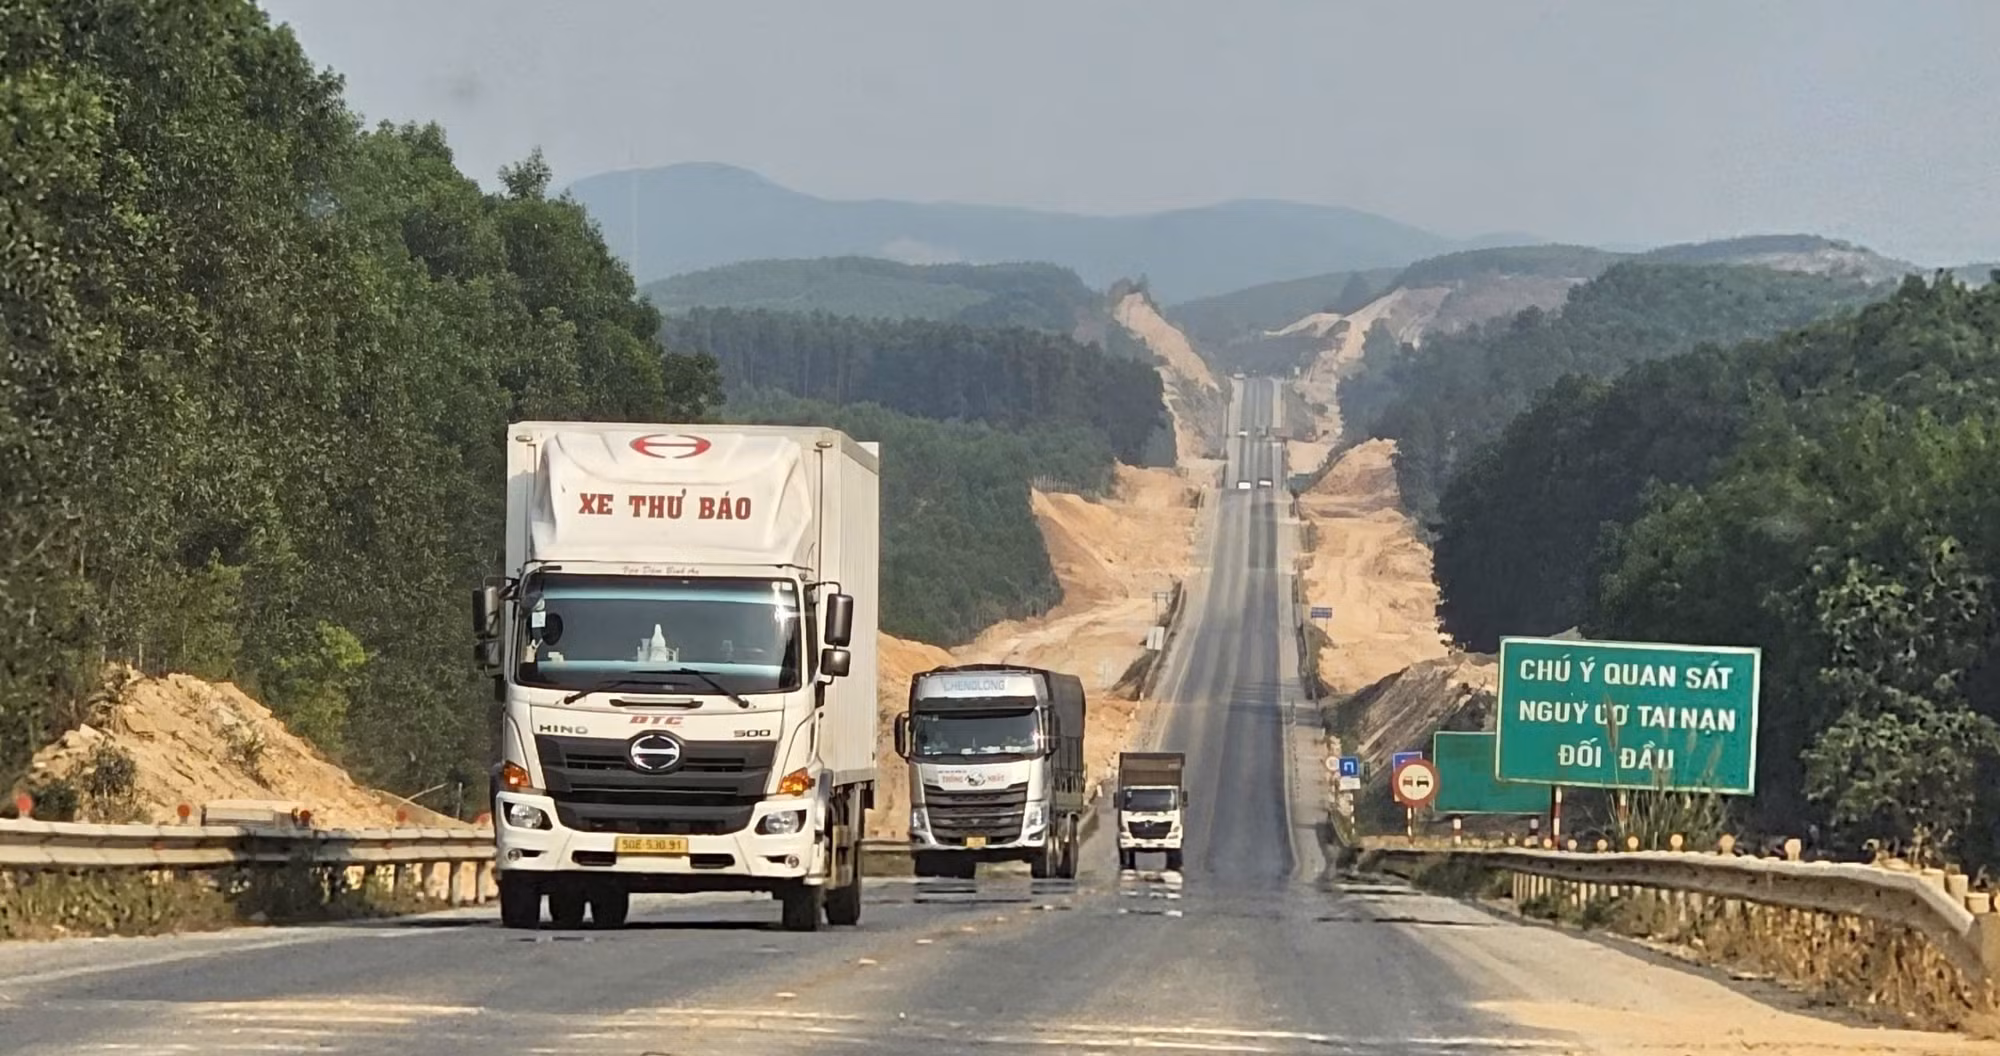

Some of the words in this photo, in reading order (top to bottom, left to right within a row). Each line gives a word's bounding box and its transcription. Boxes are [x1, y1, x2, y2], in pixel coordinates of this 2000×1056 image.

[578, 493, 614, 515] XE
[628, 488, 687, 519] THƯ
[698, 491, 752, 520] BÁO
[1520, 653, 1571, 682] CHÚ
[1579, 656, 1596, 683] Ý
[1604, 663, 1676, 688] QUAN
[1685, 660, 1734, 690] SÁT
[539, 724, 588, 735] HINO
[733, 729, 771, 737] 500
[1637, 705, 1675, 729] TAI
[1680, 707, 1736, 735] NẠN
[1557, 737, 1602, 768] ĐỐI
[1619, 740, 1675, 770] ĐẦU
